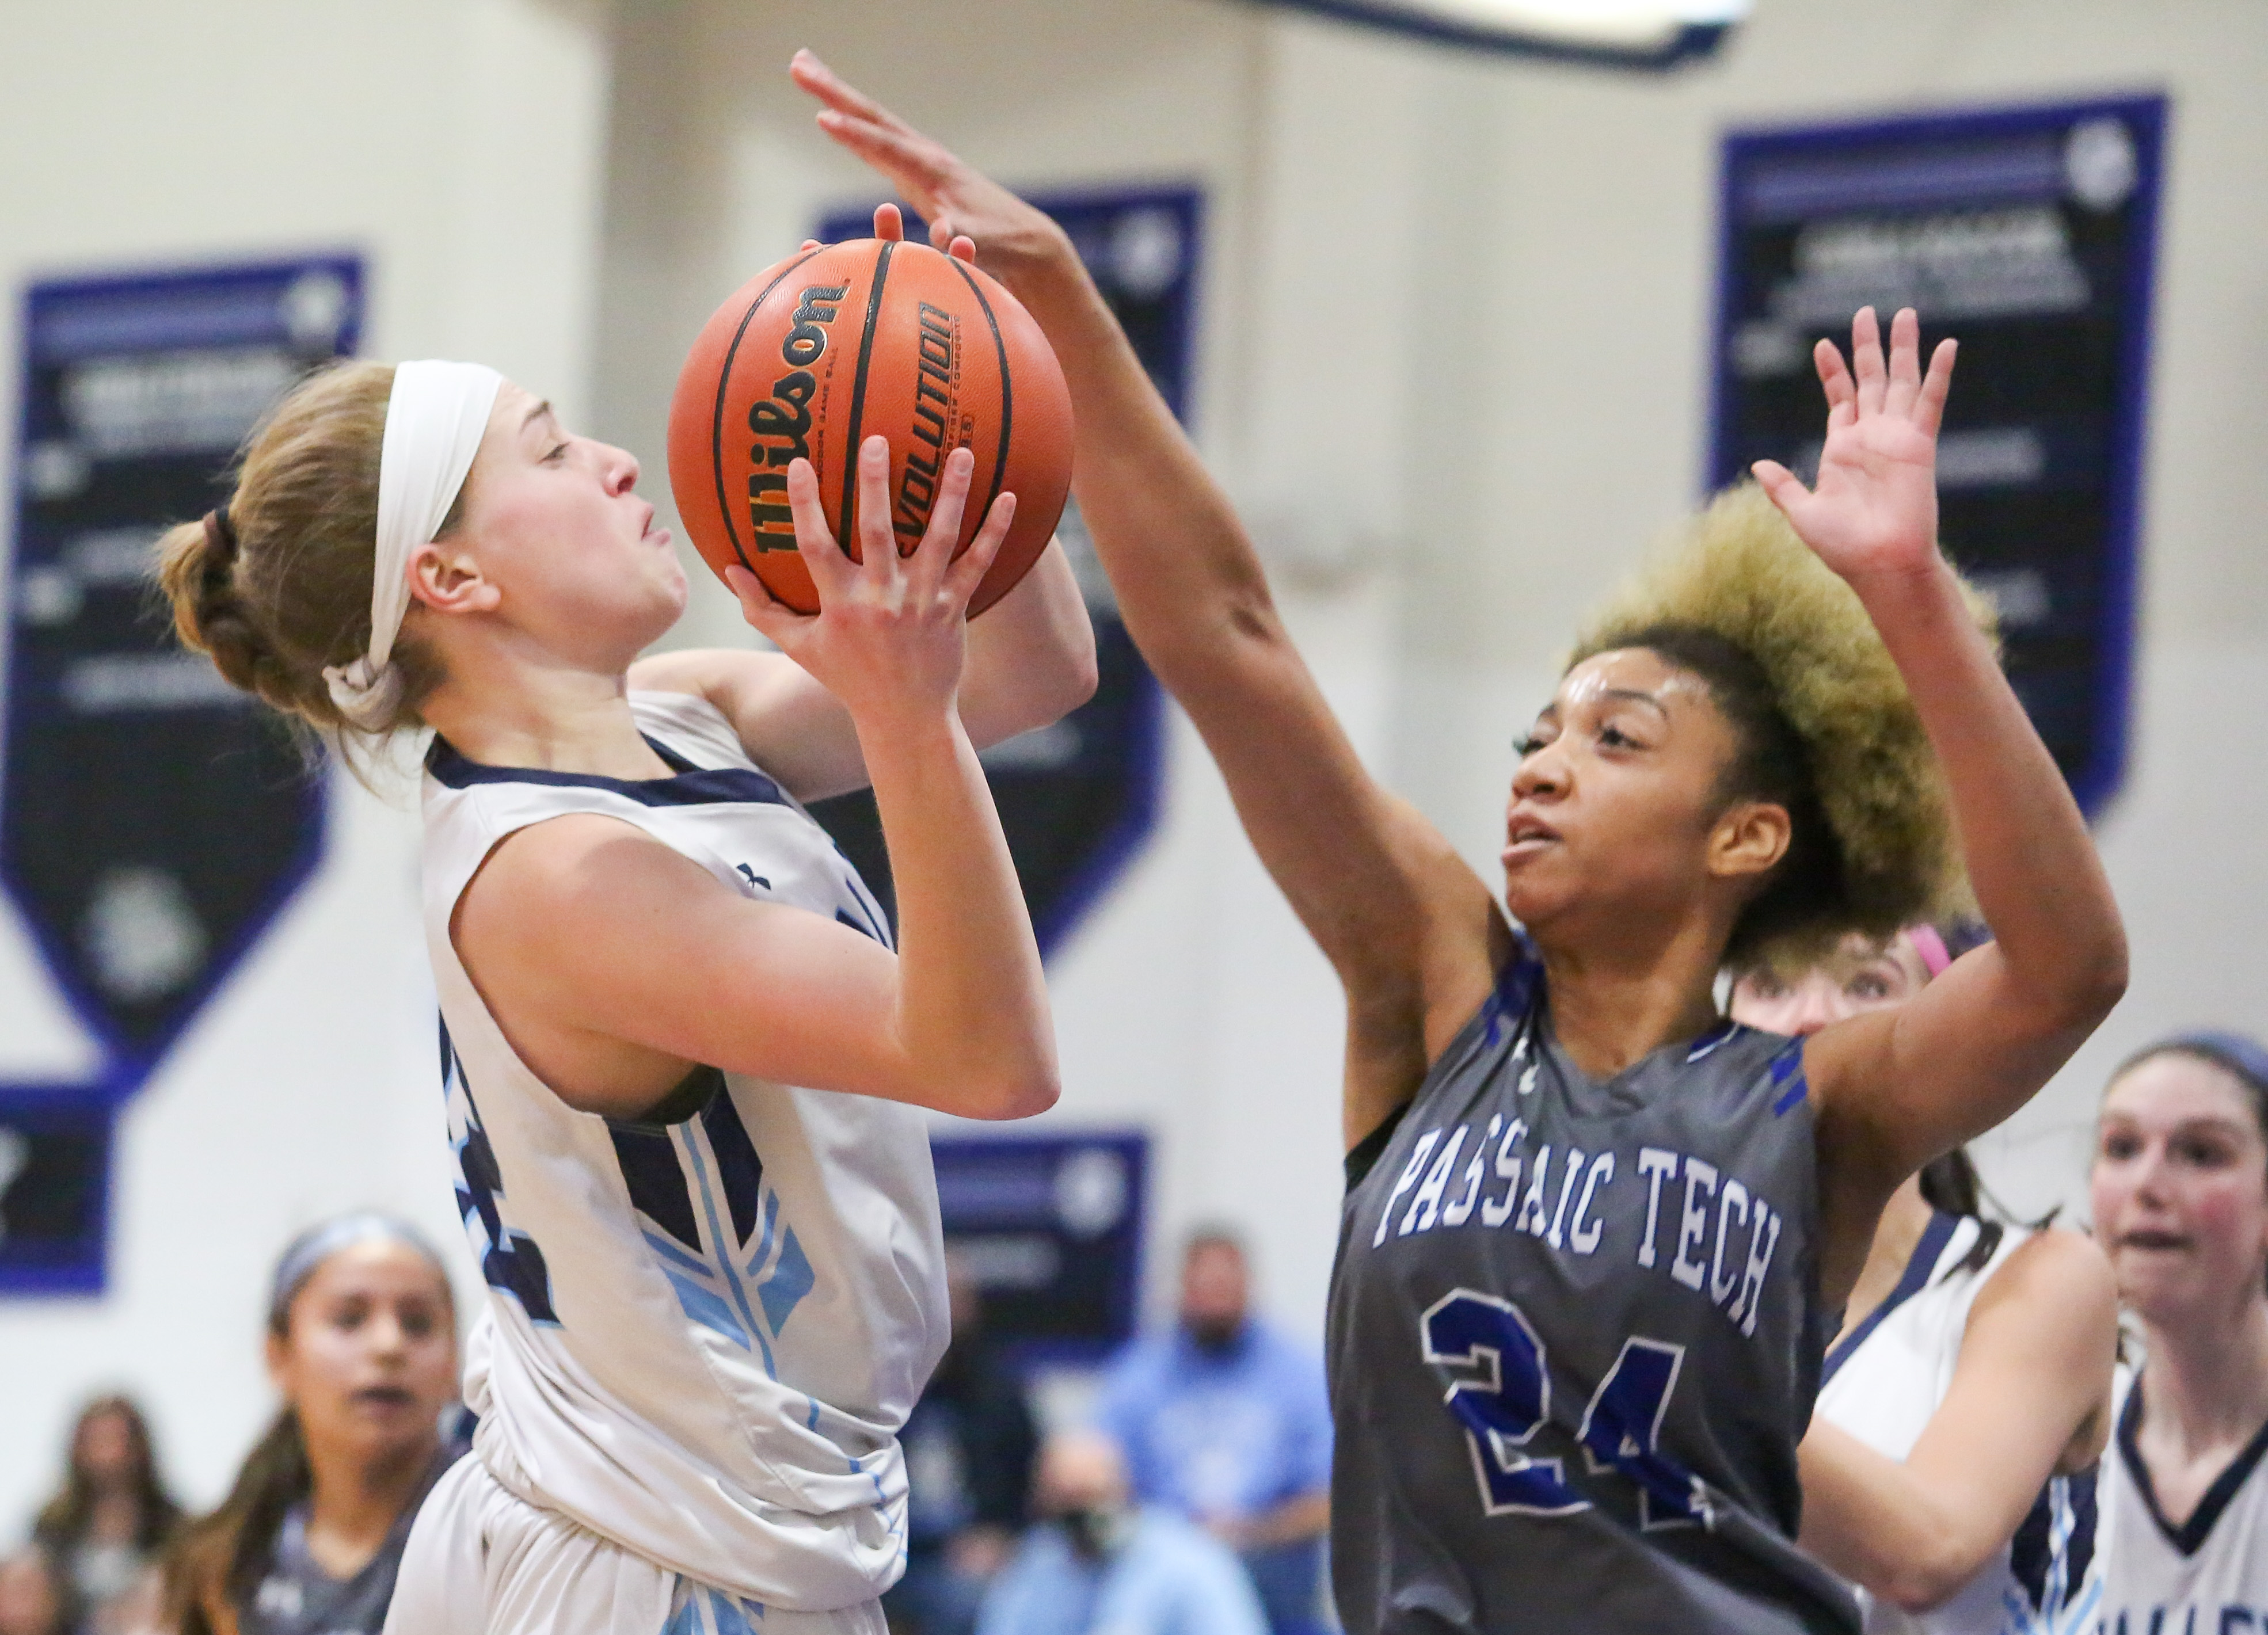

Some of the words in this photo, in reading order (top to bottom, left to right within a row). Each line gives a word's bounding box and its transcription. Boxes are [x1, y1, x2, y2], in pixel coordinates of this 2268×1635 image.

[748, 282, 849, 554] Wilson
[818, 383, 830, 424] GAME
[1372, 1112, 1616, 1255] PASSAIC
[1636, 1146, 1781, 1339] TECH
[1420, 1286, 1716, 1533] 24
